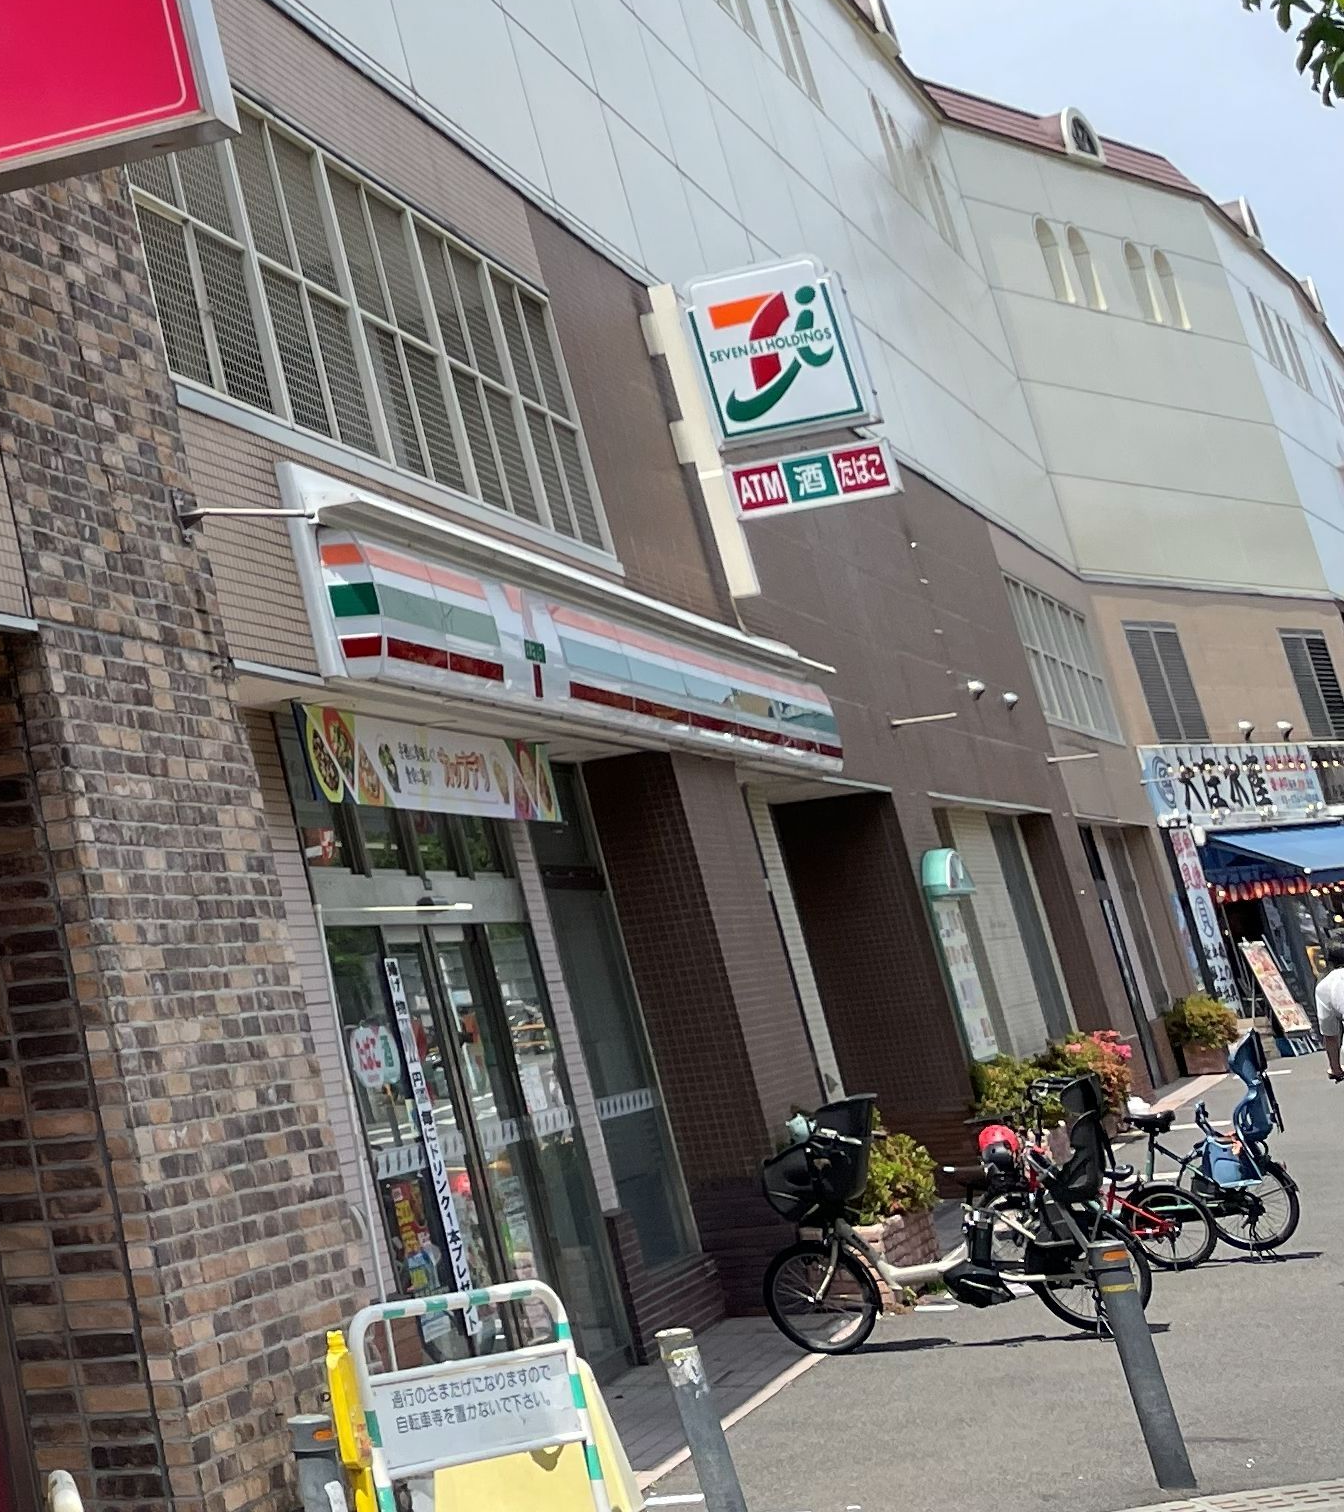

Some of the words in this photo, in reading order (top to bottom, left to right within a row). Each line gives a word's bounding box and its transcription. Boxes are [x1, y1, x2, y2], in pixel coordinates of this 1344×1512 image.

[766, 327, 832, 351] HOLDINGS
[739, 470, 785, 506] ATM
[792, 462, 828, 497] 酒
[837, 453, 887, 489] たばこ
[391, 1364, 552, 1410] 通行のさまたげになりますので
[395, 1391, 552, 1434] 自転車等を置かないで下さい。
